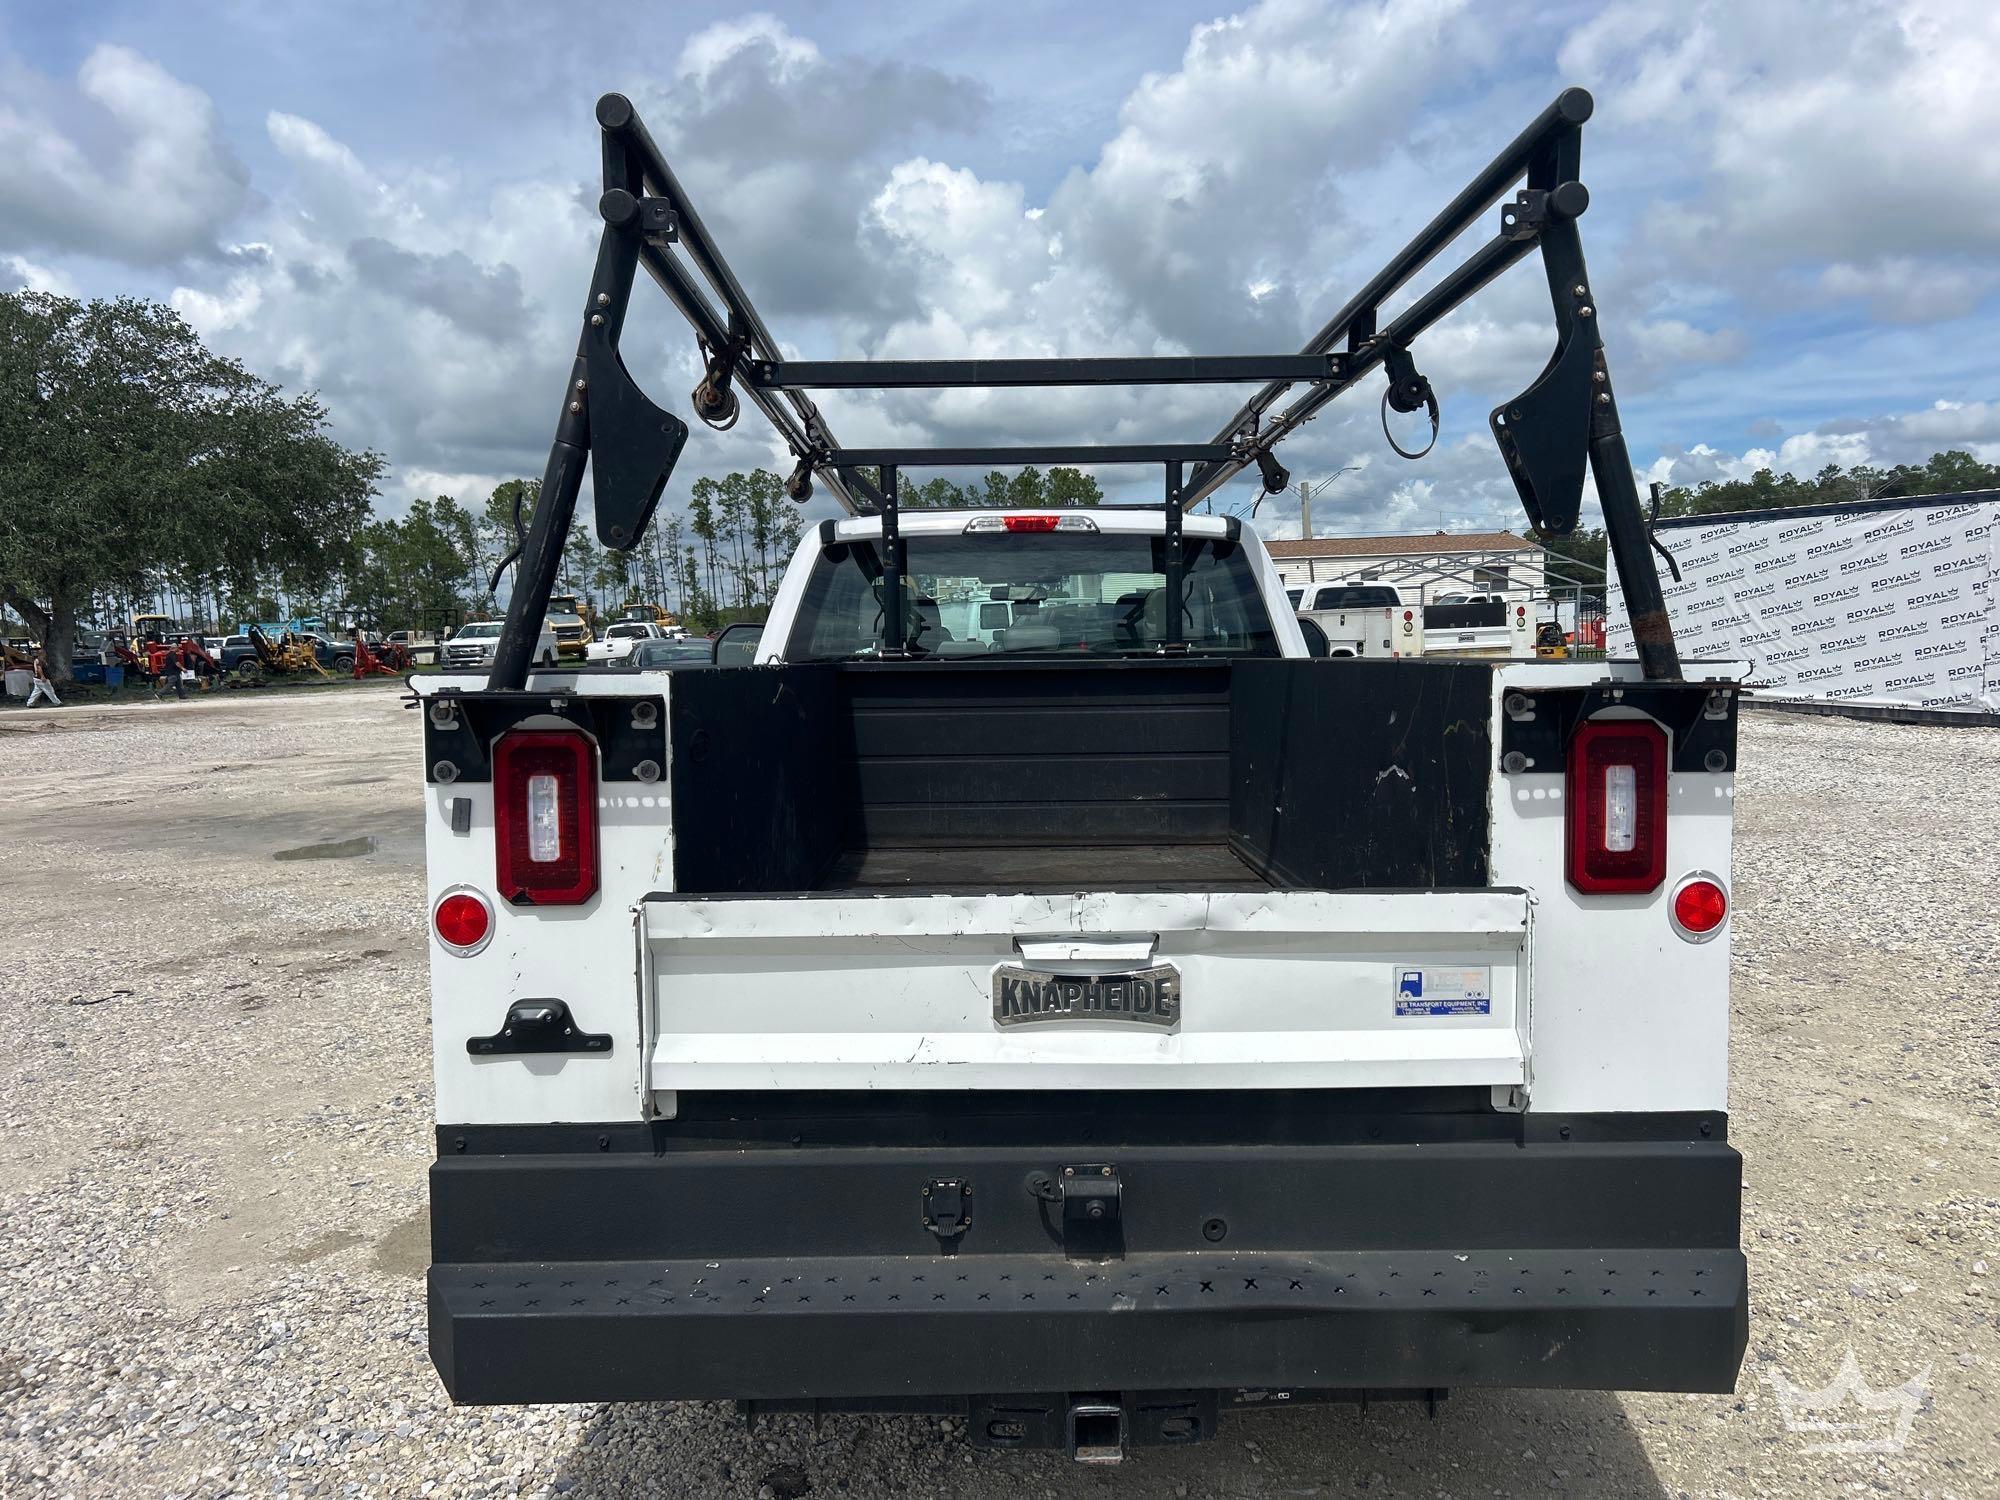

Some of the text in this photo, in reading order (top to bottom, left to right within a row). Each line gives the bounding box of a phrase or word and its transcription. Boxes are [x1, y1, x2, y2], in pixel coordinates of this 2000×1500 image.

[1834, 513, 1864, 523] ROY
[1927, 505, 1968, 521] ROYAL
[1928, 508, 1980, 527] AUCTION GROUP
[1835, 518, 1860, 527] AUCTION
[1700, 526, 1730, 540] ROYAL
[1723, 530, 1739, 538] GROUP
[1779, 525, 1813, 539] ROYAL
[1780, 528, 1823, 543] AUCTION GROUP
[1864, 524, 1903, 539] ROYAL
[1866, 527, 1914, 544] AUCTION GROUP
[1966, 525, 1991, 538] ROY
[1967, 533, 1990, 543] AUCTIO
[1729, 541, 1760, 554] ROYAL
[1807, 541, 1842, 555] ROYAL
[1808, 544, 1853, 560] AUCTION GROUP
[1901, 540, 1940, 555] ROYAL
[1902, 543, 1952, 560] AUCTION GROUP
[1682, 555, 1711, 568] ROYAL
[1730, 551, 1751, 559] AUCTION
[1755, 556, 1787, 570] ROYAL
[1840, 556, 1877, 571] ROYAL
[1842, 560, 1888, 576] AUCTION GROUP
[1934, 558, 1975, 573] ROYAL
[1935, 562, 1987, 578] AUCTION GROUP
[1706, 571, 1736, 583] ROYAL
[1785, 572, 1819, 585] ROYAL
[1871, 574, 1910, 588] ROYAL
[1662, 584, 1689, 595] ROYAL
[1786, 582, 1809, 590] AUCTION
[1873, 578, 1921, 593] AUCTION GROUP
[1734, 586, 1766, 599] ROYAL
[1814, 589, 1849, 602] ROYAL
[1908, 591, 1947, 605] ROYAL
[1687, 599, 1716, 611] ROYAL
[1815, 593, 1860, 607] AUCTION GROUP
[1909, 596, 1960, 610] AUCTION GROUP
[1761, 603, 1793, 615] ROYAL
[1847, 606, 1884, 619] ROYAL
[1712, 616, 1742, 628] ROYAL
[1849, 610, 1895, 624] AUCTION GROUP
[1941, 610, 1983, 624] ROYAL
[1791, 619, 1826, 632] ROYAL
[1879, 624, 1917, 638] ROYAL
[1942, 620, 1971, 629] AUCTION
[1673, 627, 1694, 637] OYAL
[1740, 632, 1772, 644] ROYAL
[1880, 634, 1906, 642] AUCTION
[1692, 643, 1722, 654] ROYAL
[1820, 638, 1856, 650] ROYAL
[1915, 643, 1955, 656] ROYAL
[1766, 650, 1799, 661] ROYAL
[1854, 656, 1892, 668] ROYAL
[1798, 667, 1832, 679] ROYAL
[1949, 665, 1982, 676] ROYA
[1885, 675, 1924, 687] ROYAL
[1826, 686, 1863, 698] ROYAL
[1922, 696, 1961, 707] ROYAL
[1000, 976, 1171, 1018] KNAPHEIDE
